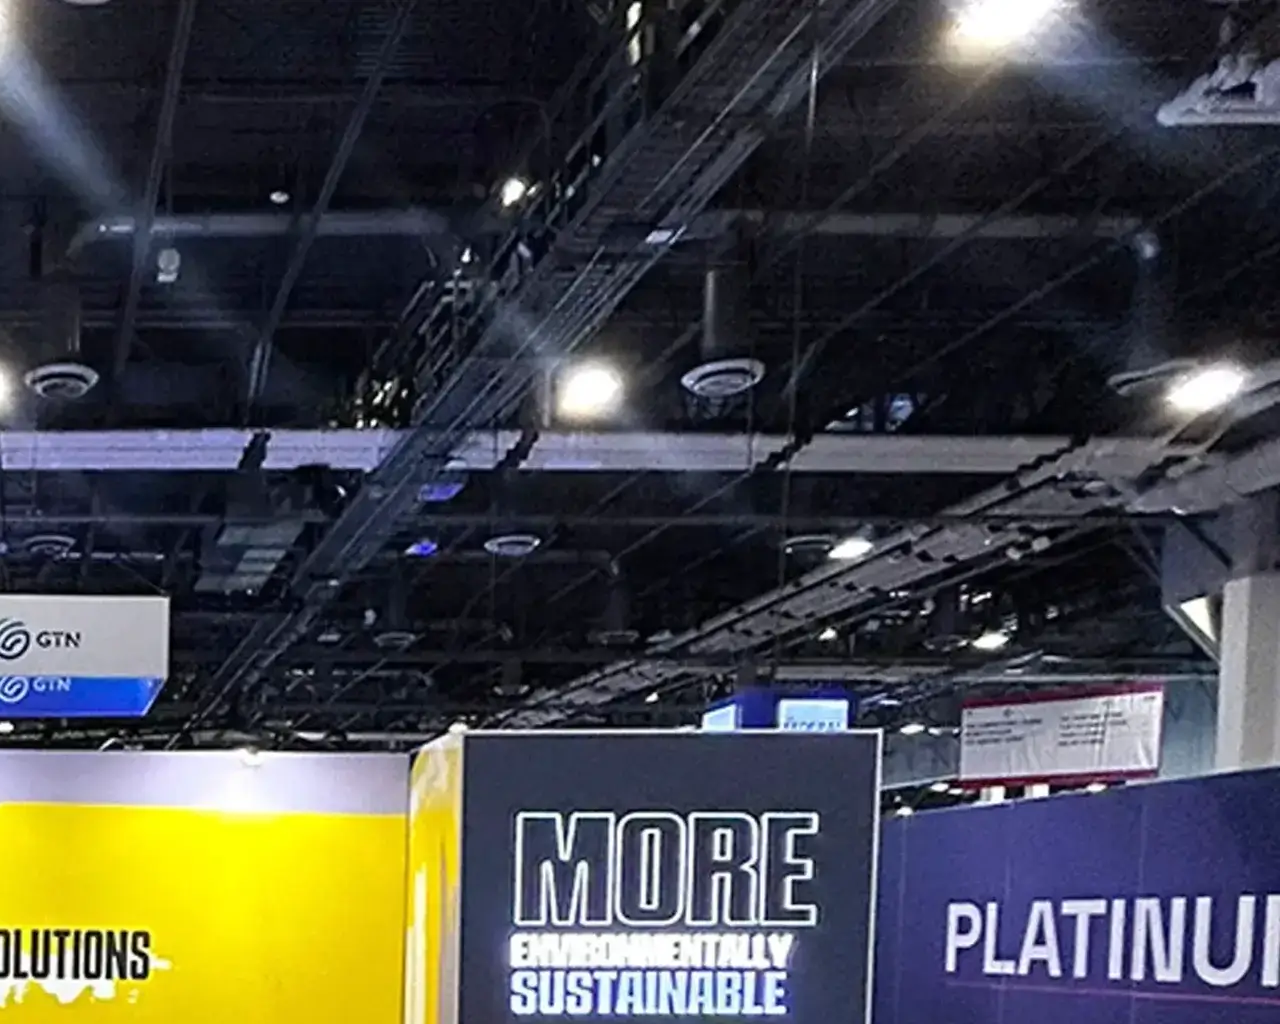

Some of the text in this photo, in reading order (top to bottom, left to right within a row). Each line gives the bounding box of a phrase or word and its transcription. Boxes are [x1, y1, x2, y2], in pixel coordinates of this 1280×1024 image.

[36, 631, 80, 648] GTN
[32, 676, 71, 692] GTN
[514, 811, 820, 926] MORE
[510, 932, 794, 969] ENVIRONMENTALLY
[510, 971, 788, 1014] SUSTAINABLE
